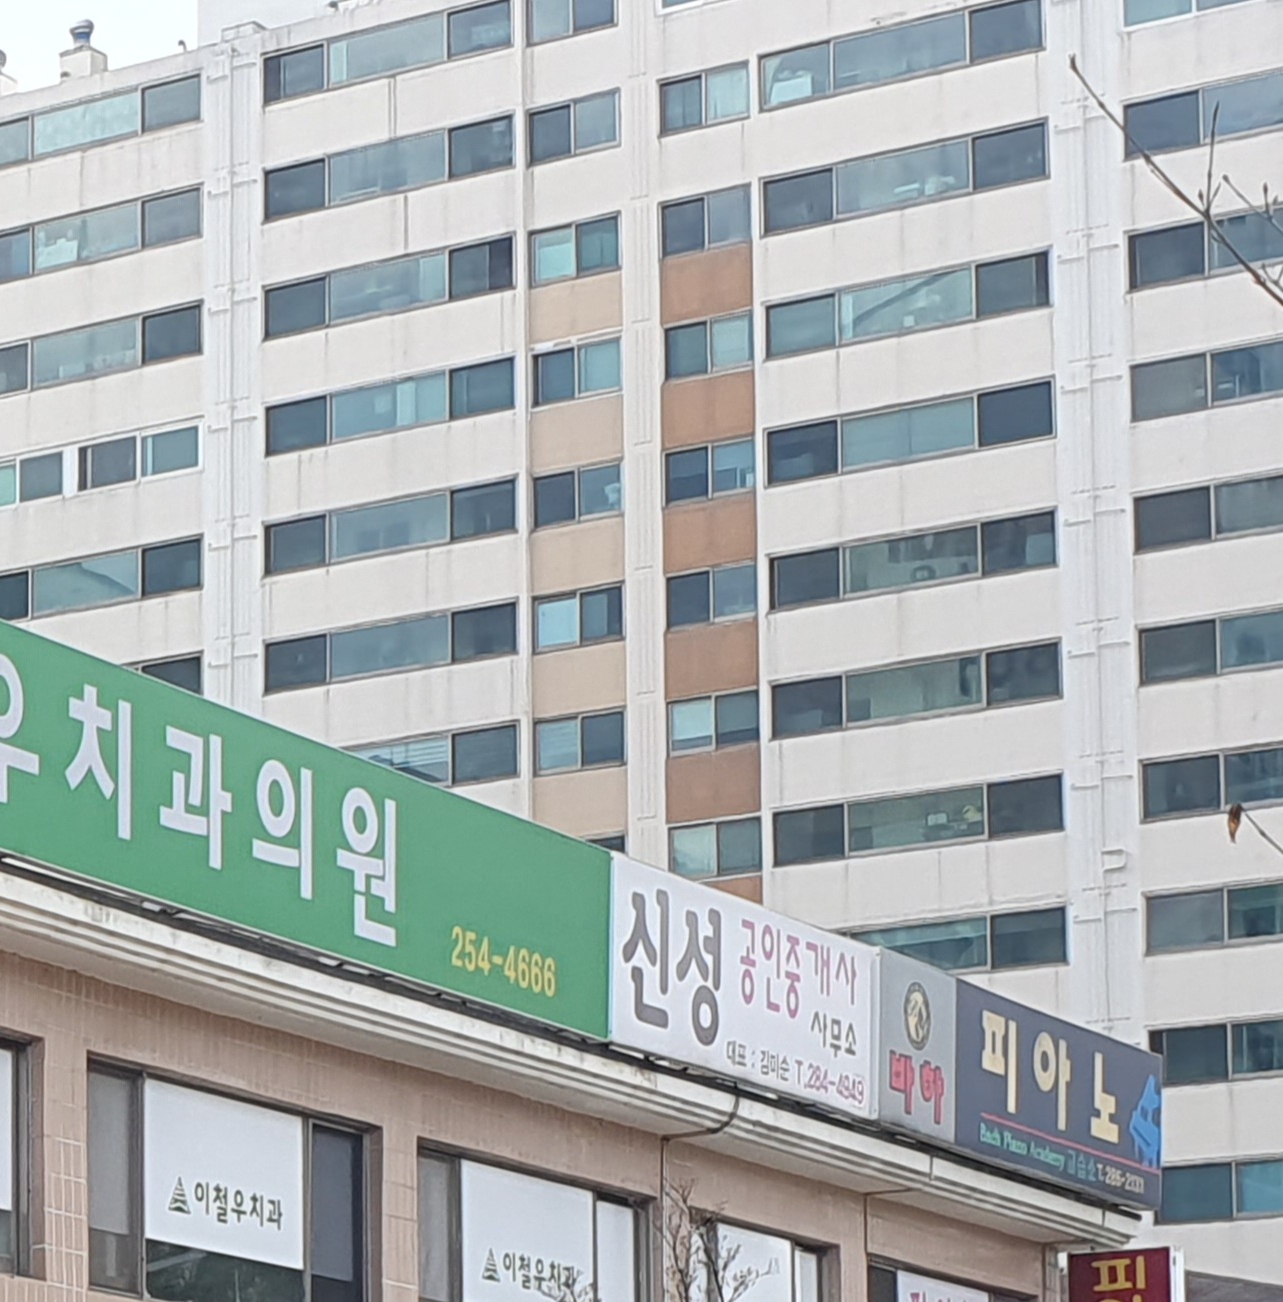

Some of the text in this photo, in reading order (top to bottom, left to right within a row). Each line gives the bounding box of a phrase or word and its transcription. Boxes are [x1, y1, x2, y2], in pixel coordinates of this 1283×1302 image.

[449, 925, 557, 998] 254-4666
[621, 888, 722, 1046] 신성
[739, 917, 857, 1019] 공인중개사
[811, 1011, 857, 1058] 사무소
[889, 1049, 945, 1125] 바하
[981, 1009, 1121, 1144] 피아노
[193, 1180, 284, 1230] 이철우치과
